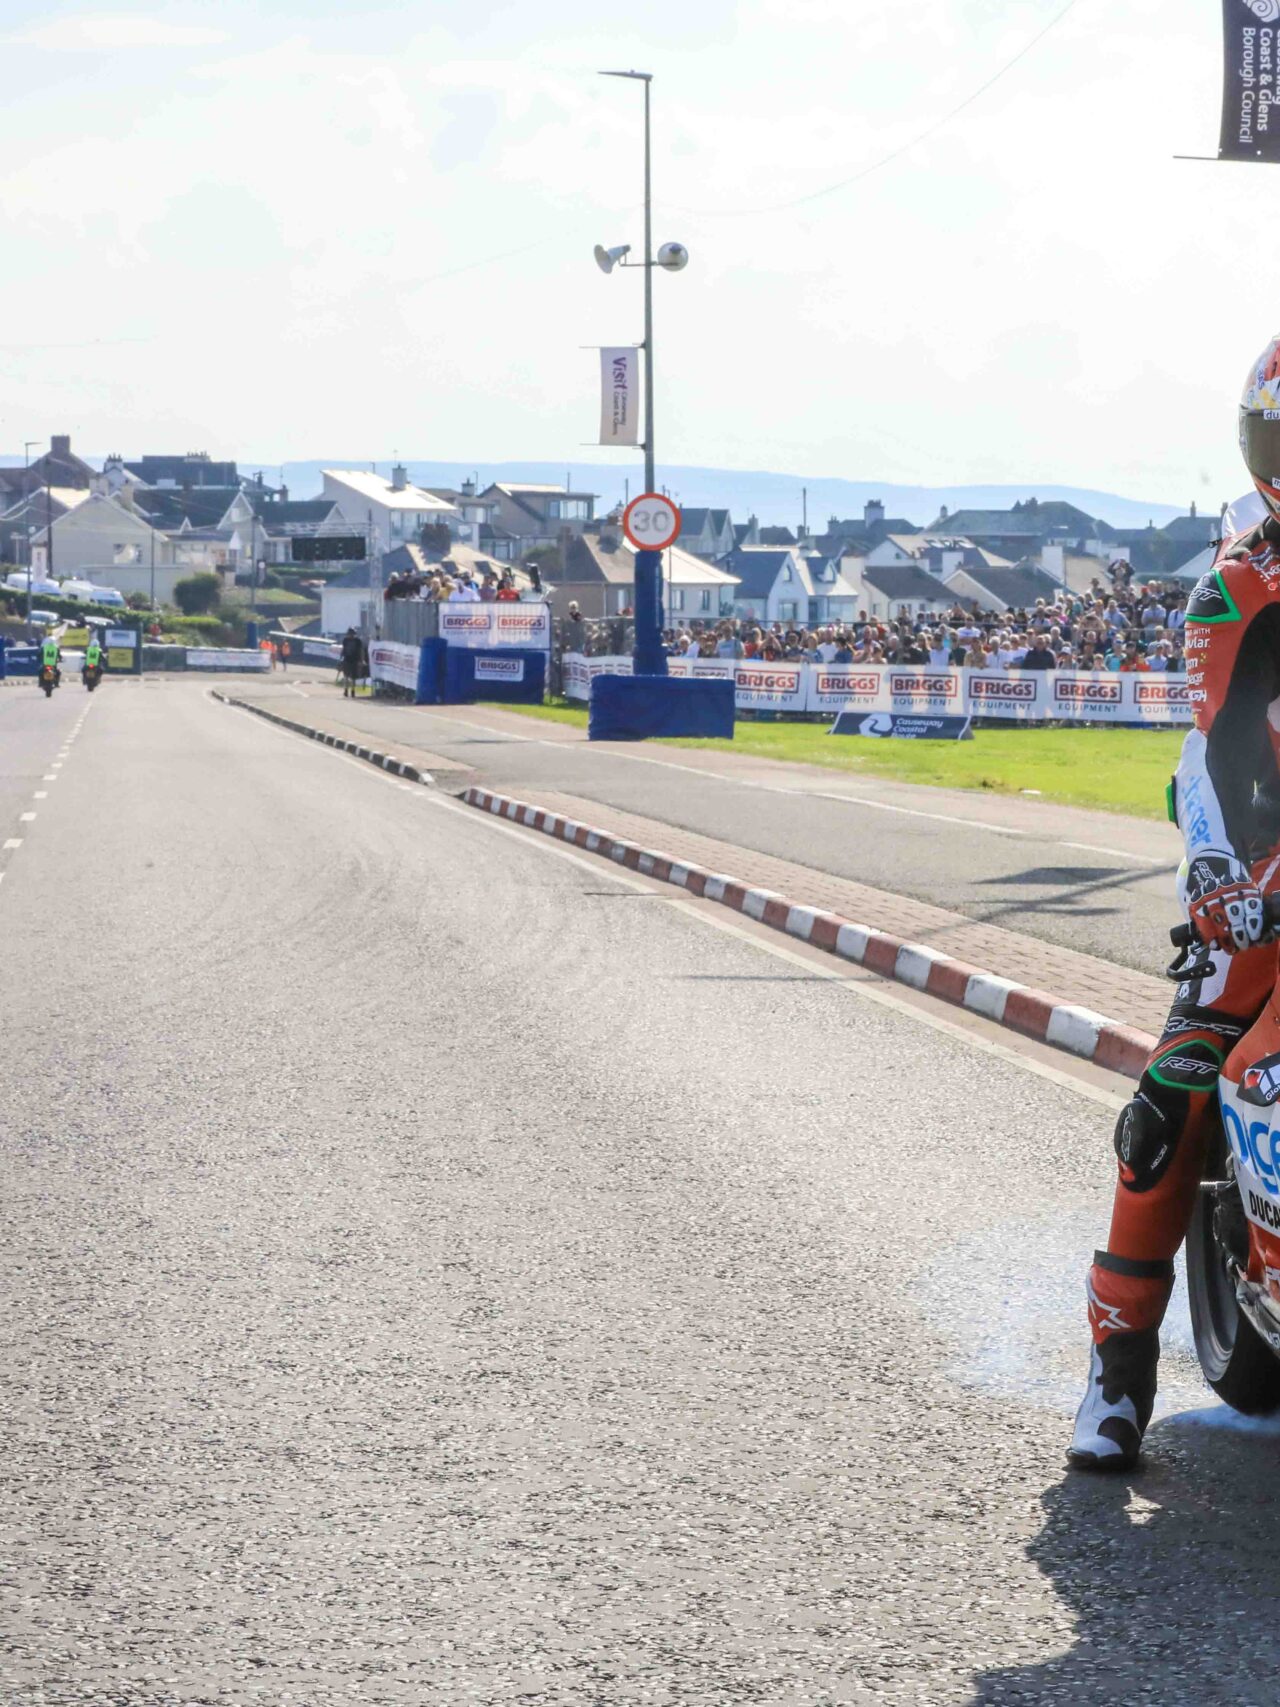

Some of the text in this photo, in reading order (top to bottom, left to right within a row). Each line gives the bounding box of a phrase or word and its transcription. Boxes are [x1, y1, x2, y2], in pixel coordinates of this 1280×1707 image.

[1239, 27, 1256, 143] Borough Council
[1257, 28, 1273, 131] Coast & Glens
[634, 510, 670, 533] 30
[446, 617, 542, 627] BRIGGS BRIGGS
[480, 661, 517, 670] BRIGGS
[737, 673, 796, 690] BRIGGS
[821, 676, 876, 691] BRIGGS
[893, 677, 953, 693] BRIGGS
[973, 681, 1033, 696] BRIGGS
[736, 692, 793, 703] EQUIPMENT
[1059, 683, 1118, 698] BRIGGS
[1138, 686, 1189, 701] BRIGG
[819, 695, 875, 705] EQUIPMENT
[893, 697, 952, 707] EQUIPMENT
[973, 699, 1032, 711] EQUIPMENT
[1058, 702, 1118, 713] EQUIPMENT
[1138, 704, 1191, 714] EQUIPMEN
[896, 718, 944, 728] Causeway
[1158, 1056, 1218, 1075] RST
